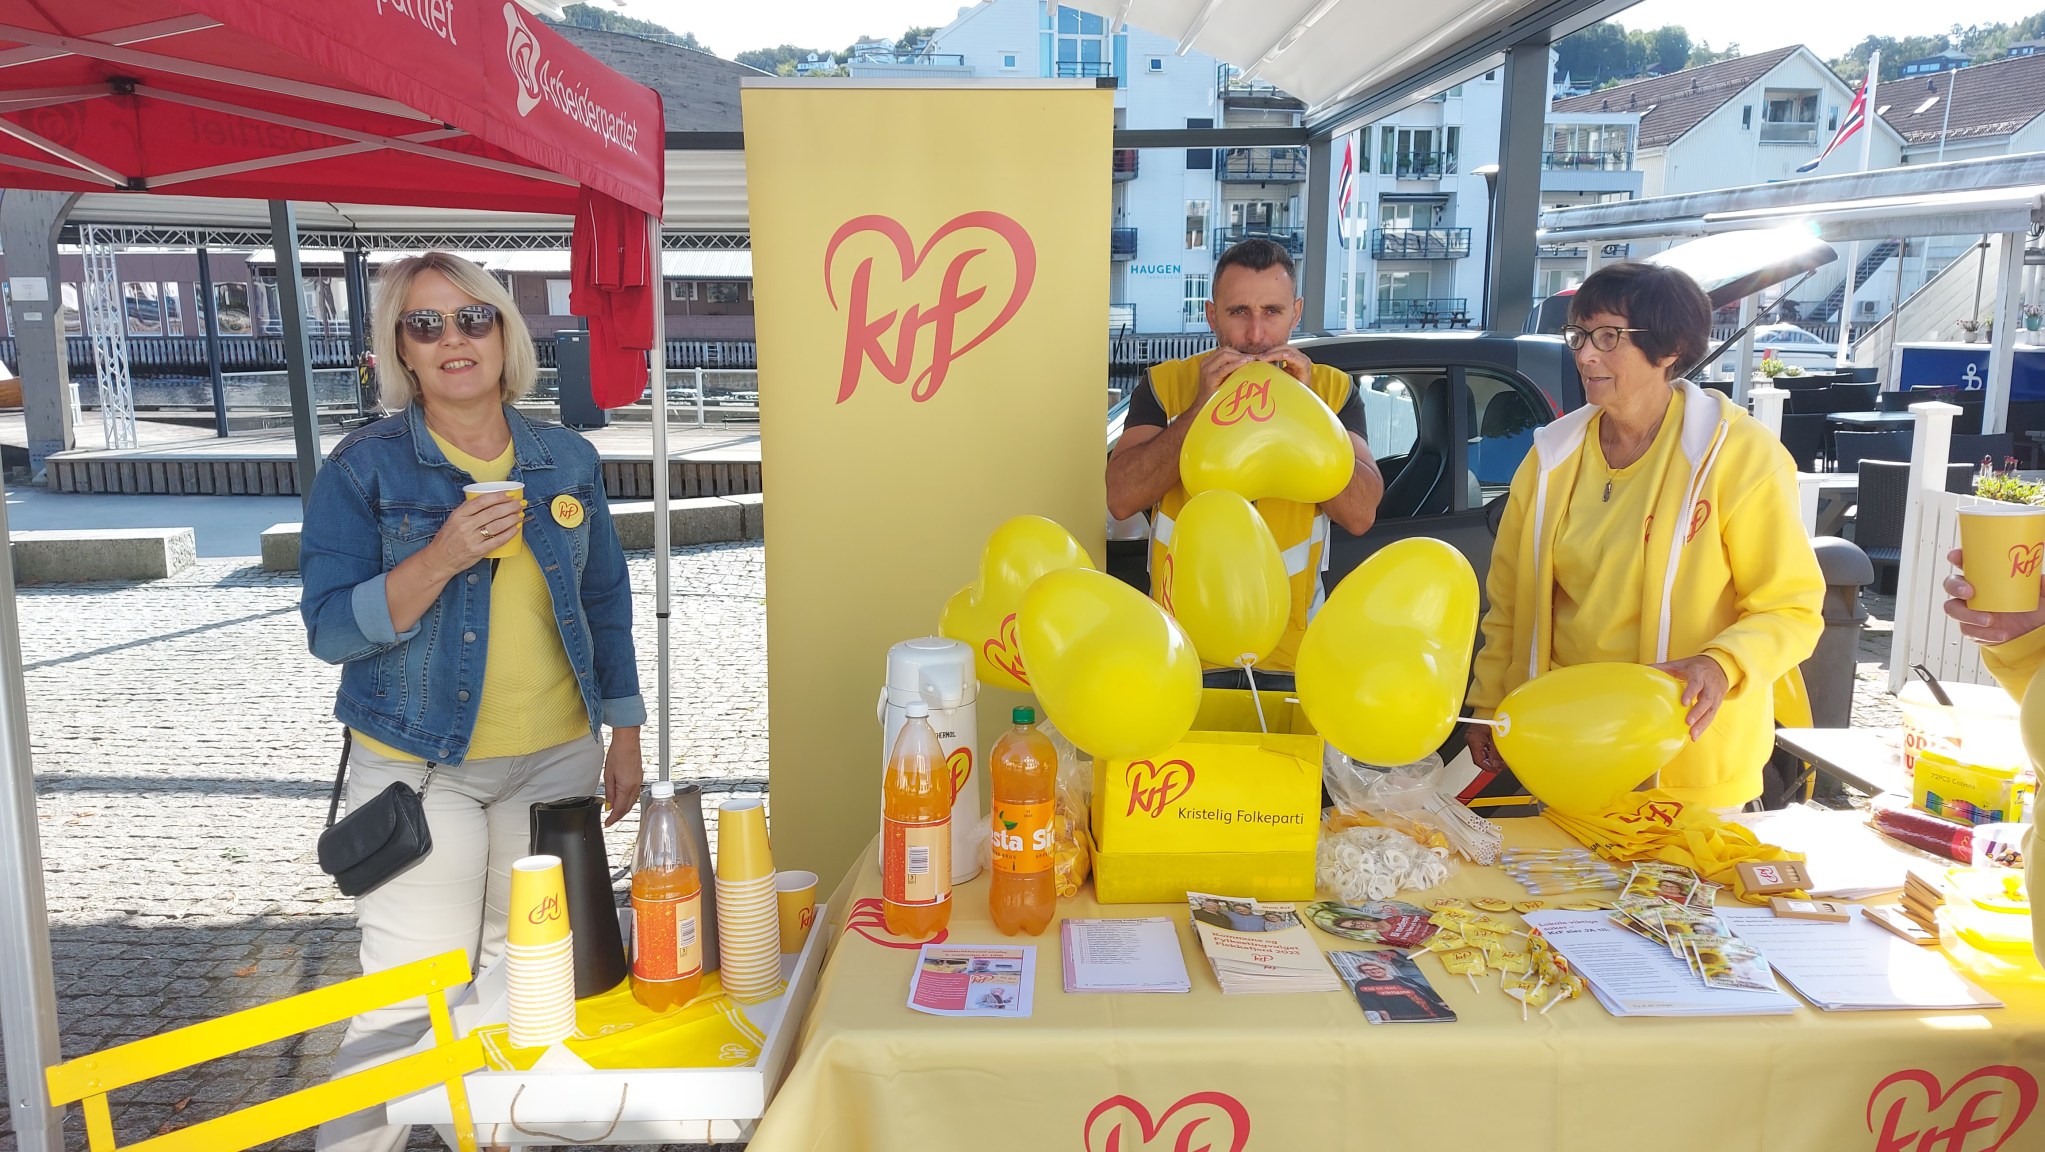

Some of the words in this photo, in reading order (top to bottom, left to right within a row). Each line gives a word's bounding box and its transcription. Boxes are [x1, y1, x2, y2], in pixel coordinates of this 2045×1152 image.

[539, 60, 639, 155] Arbeiderpartiet
[1130, 264, 1181, 274] HAUGEN
[835, 248, 987, 405] krf
[558, 503, 576, 519] krf
[2009, 547, 2042, 578] krf
[1952, 778, 1976, 790] Crayons
[1125, 769, 1180, 818] krf
[1178, 807, 1232, 825] Kristelig
[1237, 810, 1304, 826] Folkeparti
[992, 829, 1024, 852] sta
[1569, 919, 1599, 927] viktige
[1212, 932, 1264, 943] Kommune
[1265, 938, 1278, 946] og
[1215, 942, 1273, 954] Flekkefjord
